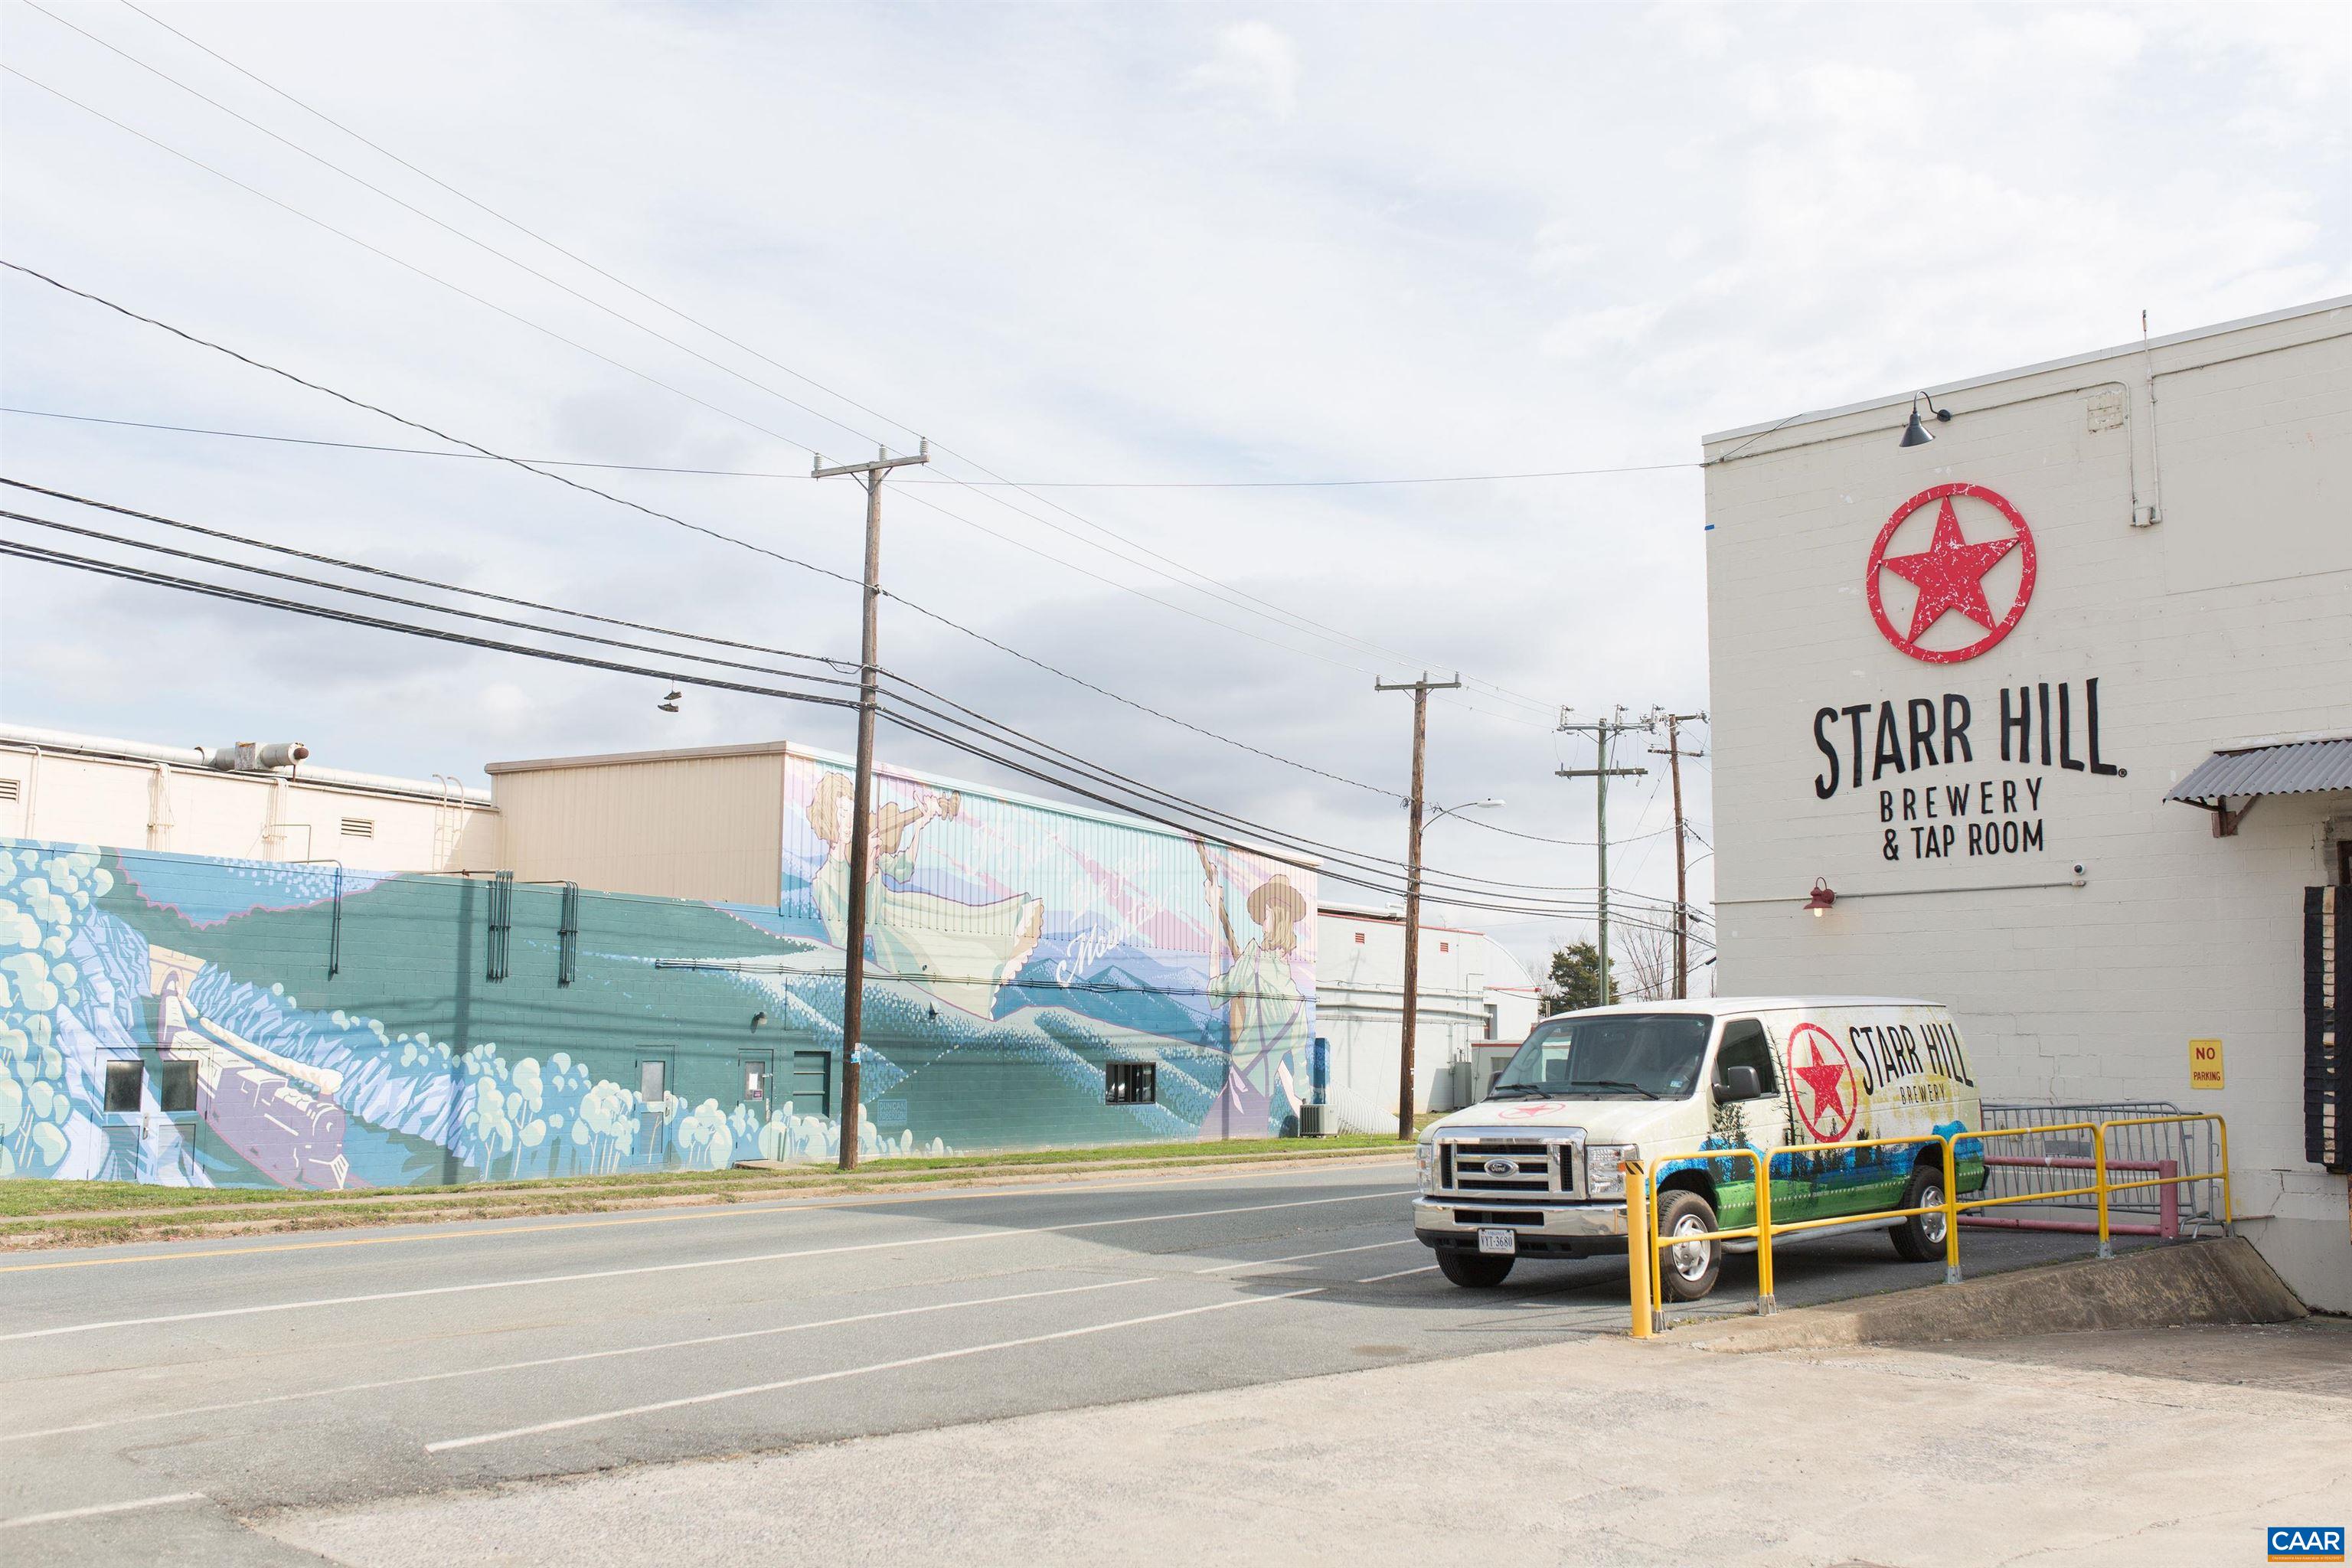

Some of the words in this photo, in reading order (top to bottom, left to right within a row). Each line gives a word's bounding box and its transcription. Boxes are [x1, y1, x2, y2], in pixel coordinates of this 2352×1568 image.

[1814, 693, 1973, 799] STARR
[2000, 678, 2118, 776] HILL
[1880, 777, 2043, 822] BREWERY
[1883, 828, 1899, 861] &
[1911, 825, 1955, 858] TAP
[1968, 819, 2043, 857] ROOM
[1849, 1024, 1923, 1096] STARR
[1919, 1023, 1974, 1087] HILL
[2196, 1047, 2216, 1060] NO
[2193, 1071, 2220, 1081] PARKING
[1900, 1083, 1945, 1105] BREWERY
[879, 1102, 906, 1110] DUNCAN
[1491, 1163, 1506, 1172] Ford
